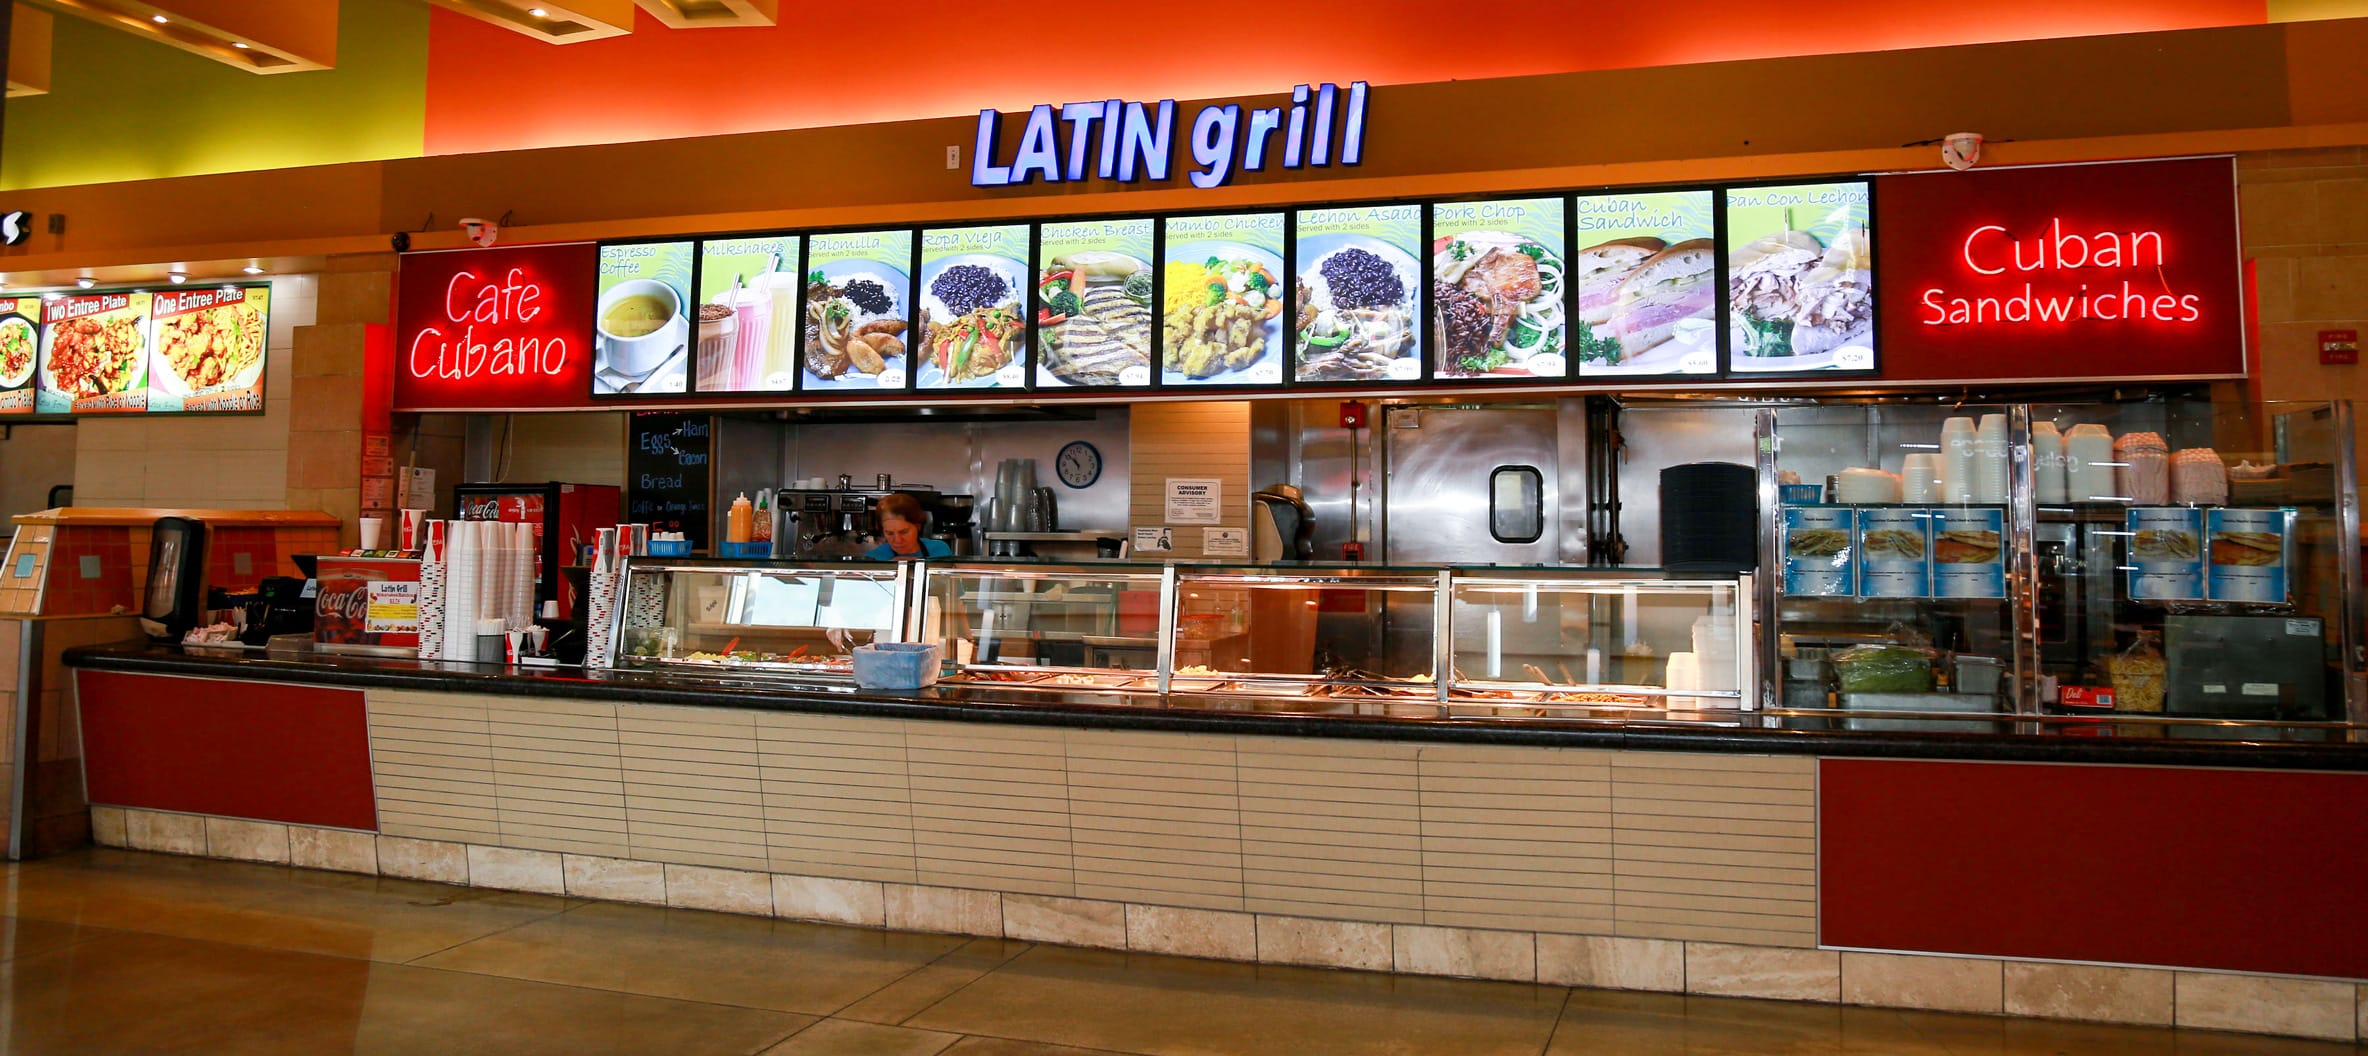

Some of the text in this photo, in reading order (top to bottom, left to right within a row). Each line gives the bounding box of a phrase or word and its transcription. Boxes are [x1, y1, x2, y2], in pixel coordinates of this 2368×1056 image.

[971, 80, 1370, 190] LATIN grill
[1578, 198, 1647, 215] Cuban
[1727, 189, 1869, 207] Pan Con Lechon
[1299, 209, 1361, 224] Lechon
[1434, 203, 1526, 224] Pork Chop
[1461, 219, 1478, 227] with
[1479, 218, 1486, 226] 2
[1487, 217, 1508, 226] sides
[1578, 210, 1684, 231] Sandwich
[1041, 223, 1150, 239] Chicken Breast
[1166, 216, 1284, 232] Mambo Chicken
[1325, 223, 1340, 231] with
[1342, 222, 1349, 230] 2
[1350, 221, 1370, 230] sides
[923, 230, 1003, 250] Ropa Vieja
[1066, 238, 1080, 246] with
[1081, 237, 1088, 245] 2
[1088, 237, 1107, 246] sides
[1190, 231, 1205, 239] with
[1207, 230, 1213, 238] 2
[1214, 230, 1233, 239] sides
[703, 239, 785, 257] Milkshakes
[809, 236, 881, 252] Palomilla
[1964, 217, 2164, 276] Cuban
[601, 245, 656, 263] Espresso
[831, 250, 846, 258] with
[846, 249, 852, 257] 2
[600, 258, 641, 279] Coffee
[154, 286, 244, 316] One Entree Plate
[446, 268, 541, 325] Cafe
[1922, 280, 2200, 326] Sandwiches
[45, 293, 127, 322] Two Entree Plate
[410, 324, 567, 380] Cubano
[682, 420, 709, 438] Ham
[640, 431, 671, 455] Eggs
[641, 474, 682, 490] Bread
[381, 584, 408, 592] Latin Grill
